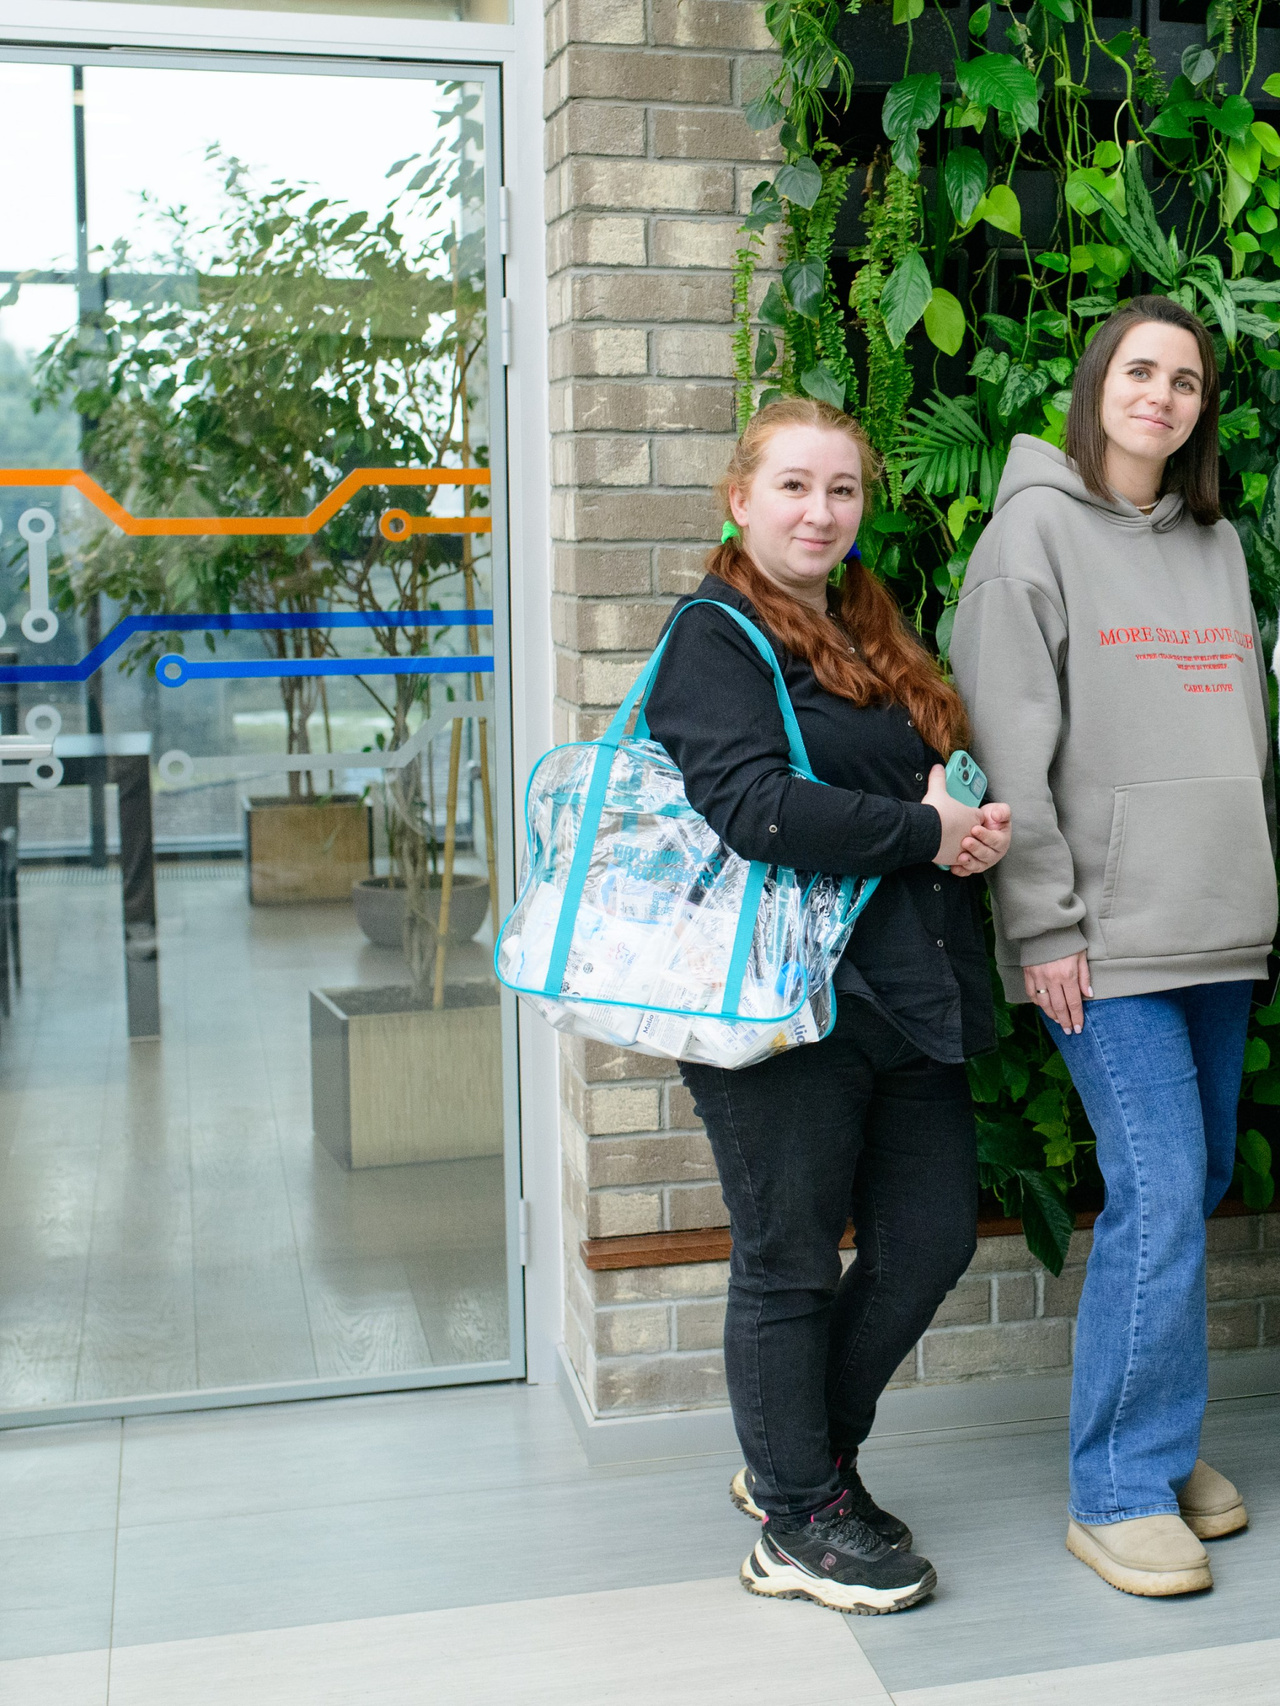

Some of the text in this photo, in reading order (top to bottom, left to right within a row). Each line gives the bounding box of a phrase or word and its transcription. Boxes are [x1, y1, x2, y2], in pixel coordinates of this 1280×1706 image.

[1098, 627, 1154, 646] MORE
[1156, 628, 1190, 644] SELF
[1193, 628, 1234, 644] LOVE
[1184, 683, 1204, 692] CARE
[1212, 683, 1234, 692] LOVE
